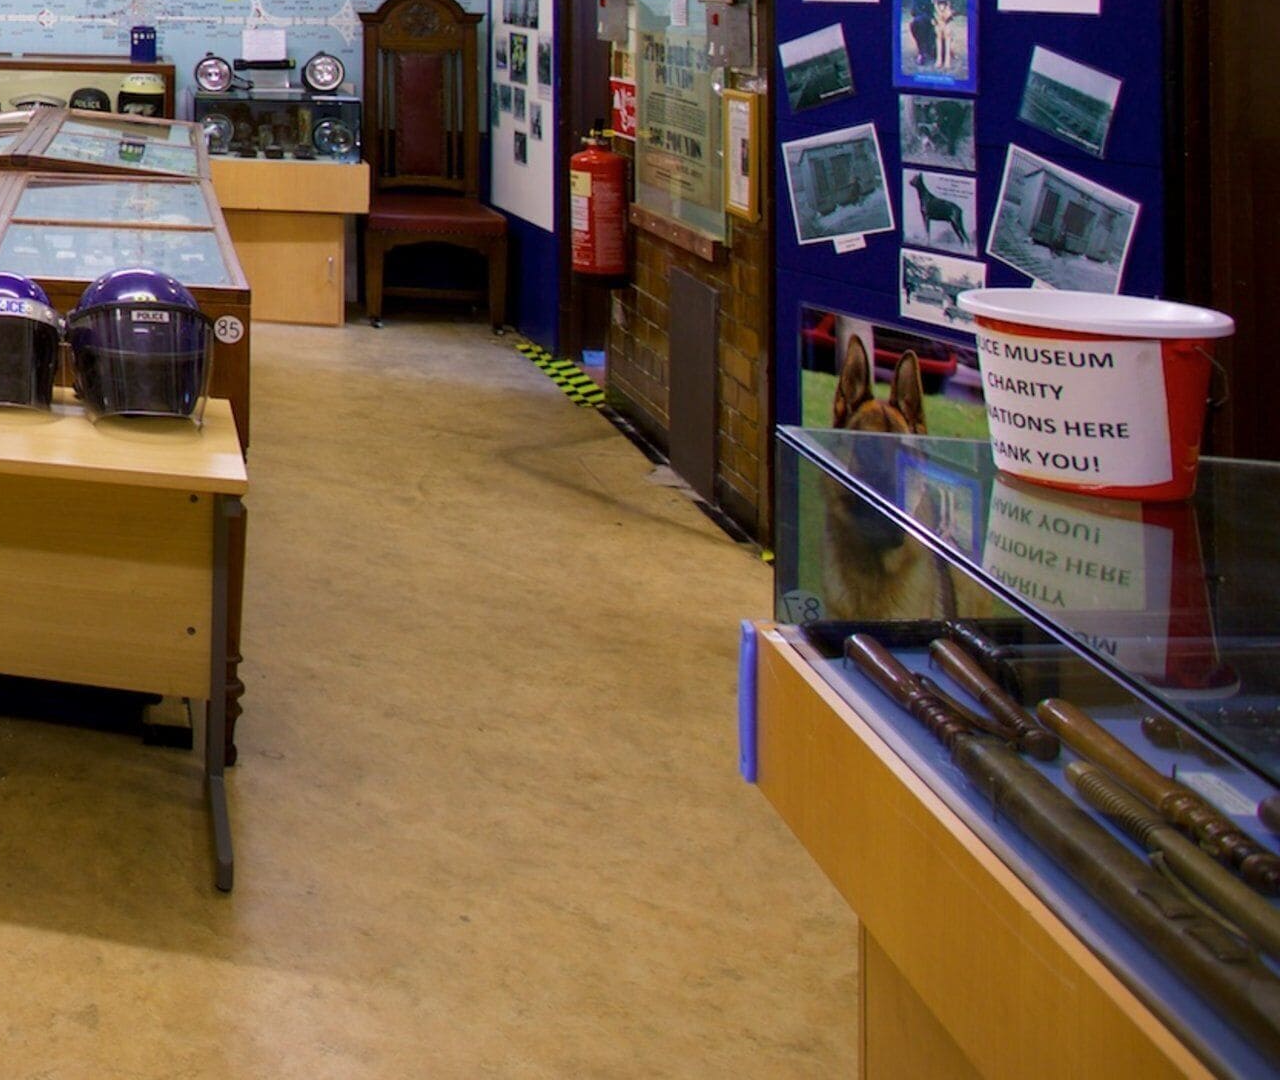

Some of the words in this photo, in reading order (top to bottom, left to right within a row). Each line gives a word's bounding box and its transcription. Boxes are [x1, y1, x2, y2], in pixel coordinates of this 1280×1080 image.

[137, 311, 166, 321] POLICE
[218, 318, 240, 338] 85
[979, 336, 1000, 357] LICE
[1005, 344, 1114, 368] MUSEUM
[988, 372, 1063, 400] CHARITY
[990, 406, 1057, 434] NATIONS
[1065, 421, 1130, 439] HERE
[1037, 450, 1100, 473] YOU!
